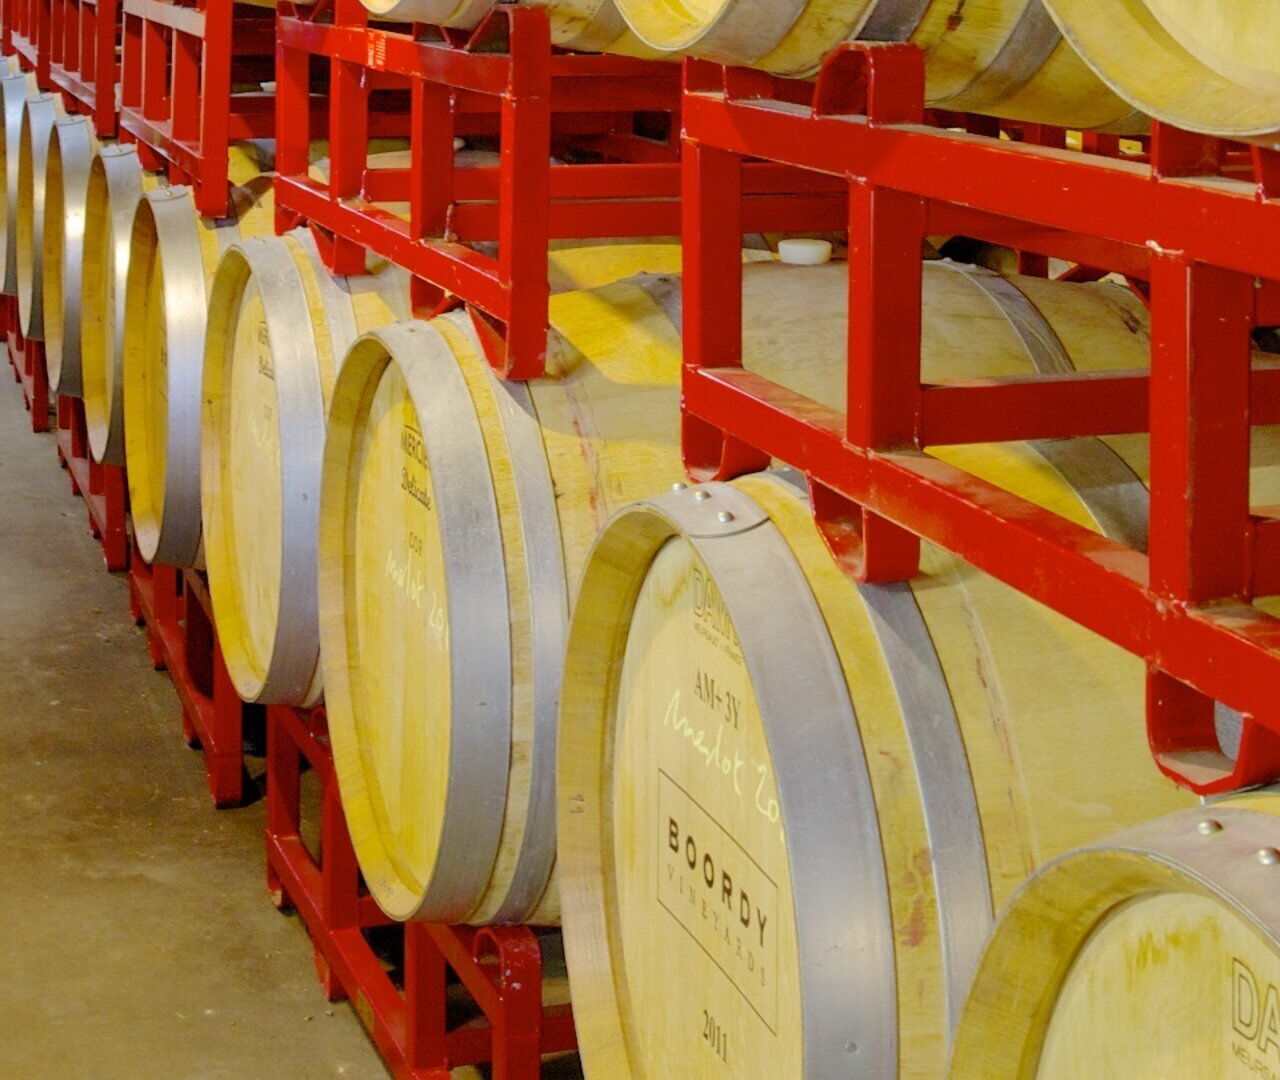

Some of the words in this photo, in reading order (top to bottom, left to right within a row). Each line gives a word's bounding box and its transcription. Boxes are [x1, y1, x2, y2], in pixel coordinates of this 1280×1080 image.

[667, 863, 767, 987] VINEYARDS
[668, 815, 768, 948] BOORDY
[703, 1008, 727, 1063] 2011
